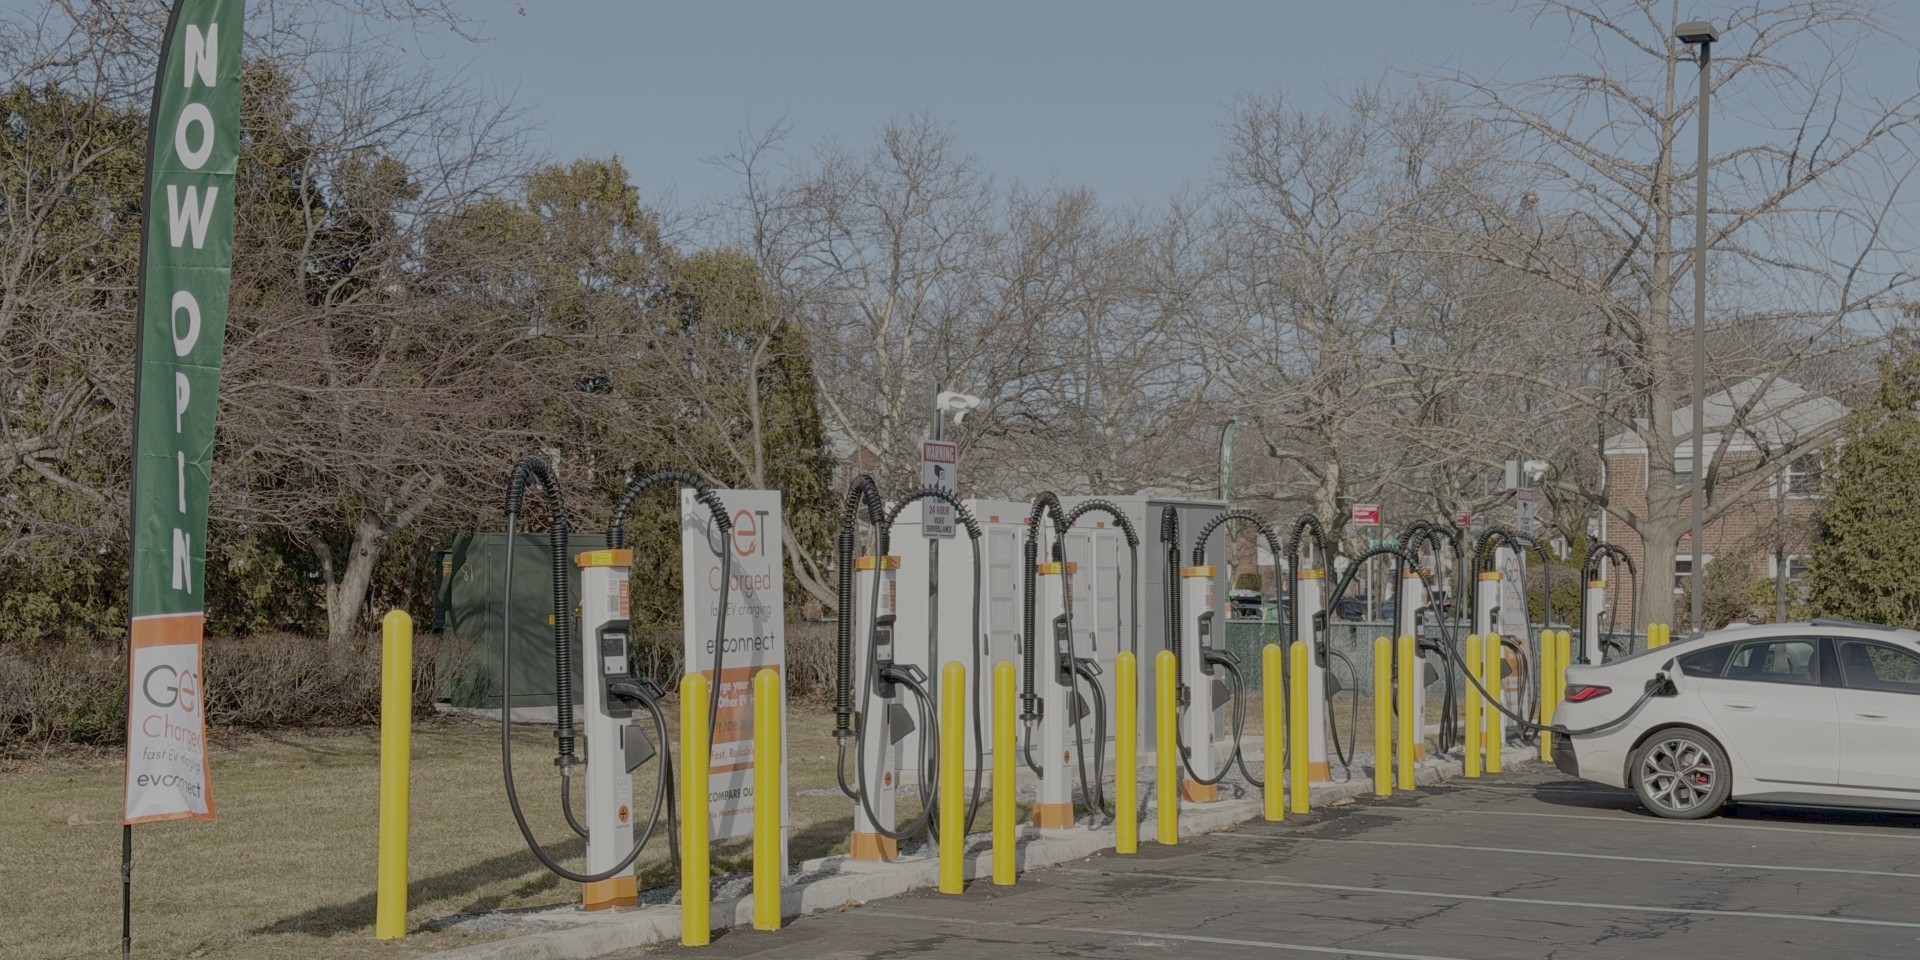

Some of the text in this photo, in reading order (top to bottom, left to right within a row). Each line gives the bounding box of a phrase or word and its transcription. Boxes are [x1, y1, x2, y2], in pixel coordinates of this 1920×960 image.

[167, 23, 219, 249] NOW
[709, 563, 771, 598] Carged
[706, 631, 775, 654] econnect
[709, 788, 741, 803] COMPARE
